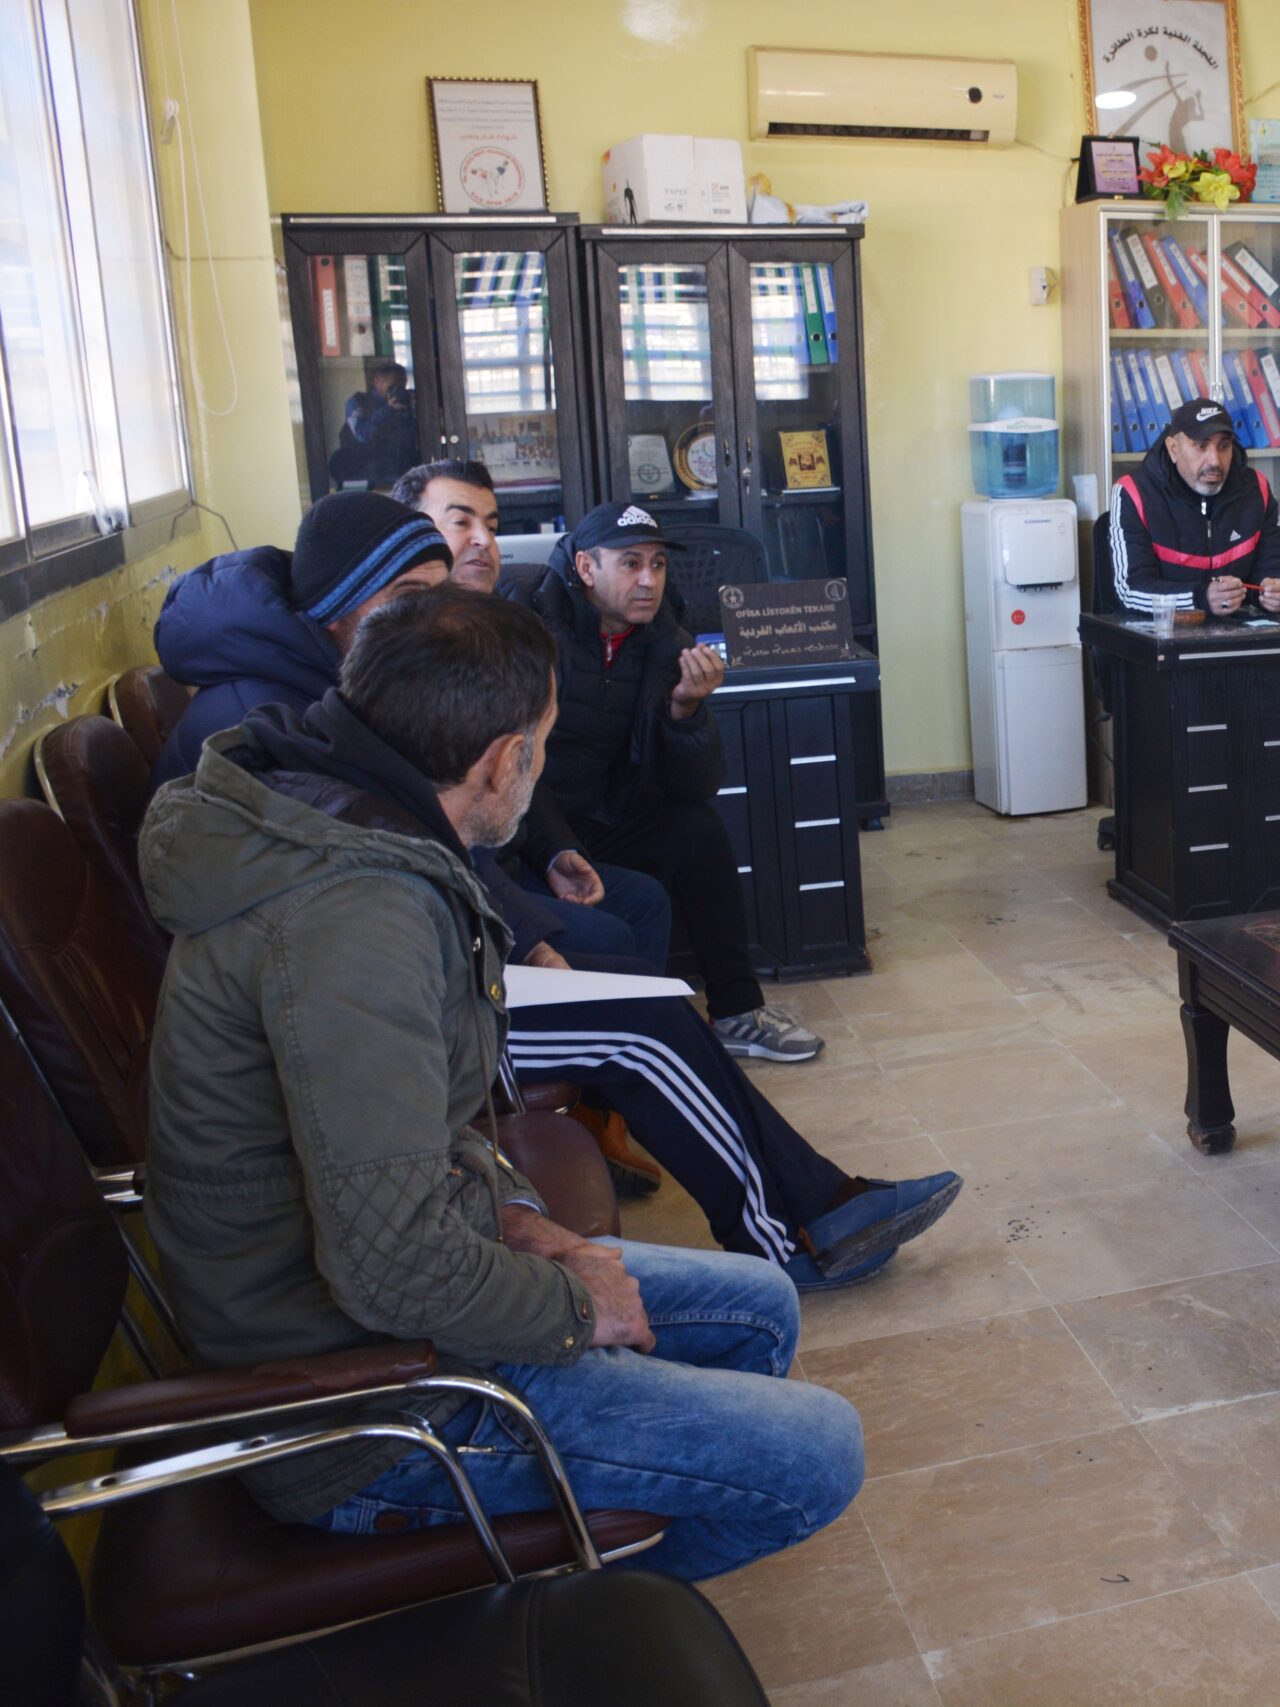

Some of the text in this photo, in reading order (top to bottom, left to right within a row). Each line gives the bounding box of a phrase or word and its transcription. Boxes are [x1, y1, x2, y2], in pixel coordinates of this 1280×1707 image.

[1136, 26, 1159, 39] لكرة
[1162, 27, 1191, 43] الفنية
[1200, 407, 1218, 415] NIKE
[808, 620, 838, 634] مكتب
